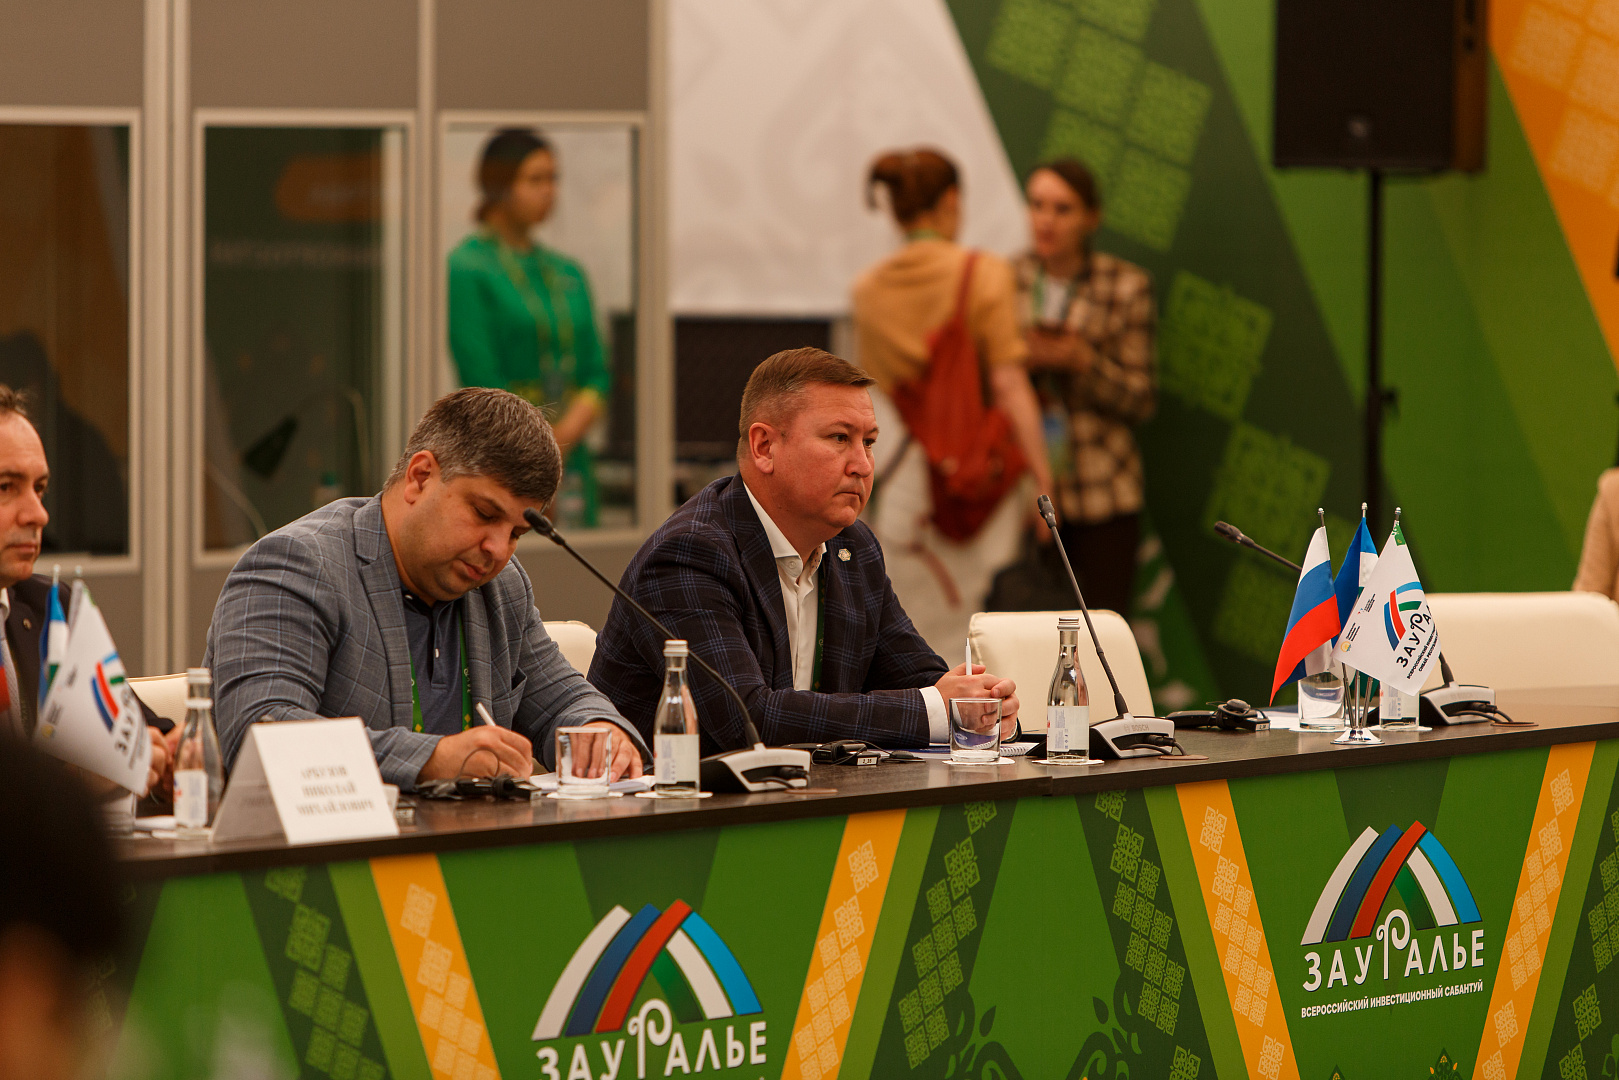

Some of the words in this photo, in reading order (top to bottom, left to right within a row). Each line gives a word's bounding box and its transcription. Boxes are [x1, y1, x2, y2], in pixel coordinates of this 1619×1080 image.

[1302, 909, 1485, 992] ЗАУРАЛЬЕ
[536, 998, 768, 1080] ЗАУРАЛЬЕ
[1301, 996, 1369, 1019] ВСЕРОССИЙСКИЙ
[1370, 984, 1444, 1009] ИНВЕСТИЦИОННЫЙ
[1444, 978, 1484, 997] САБАНТУЙ
